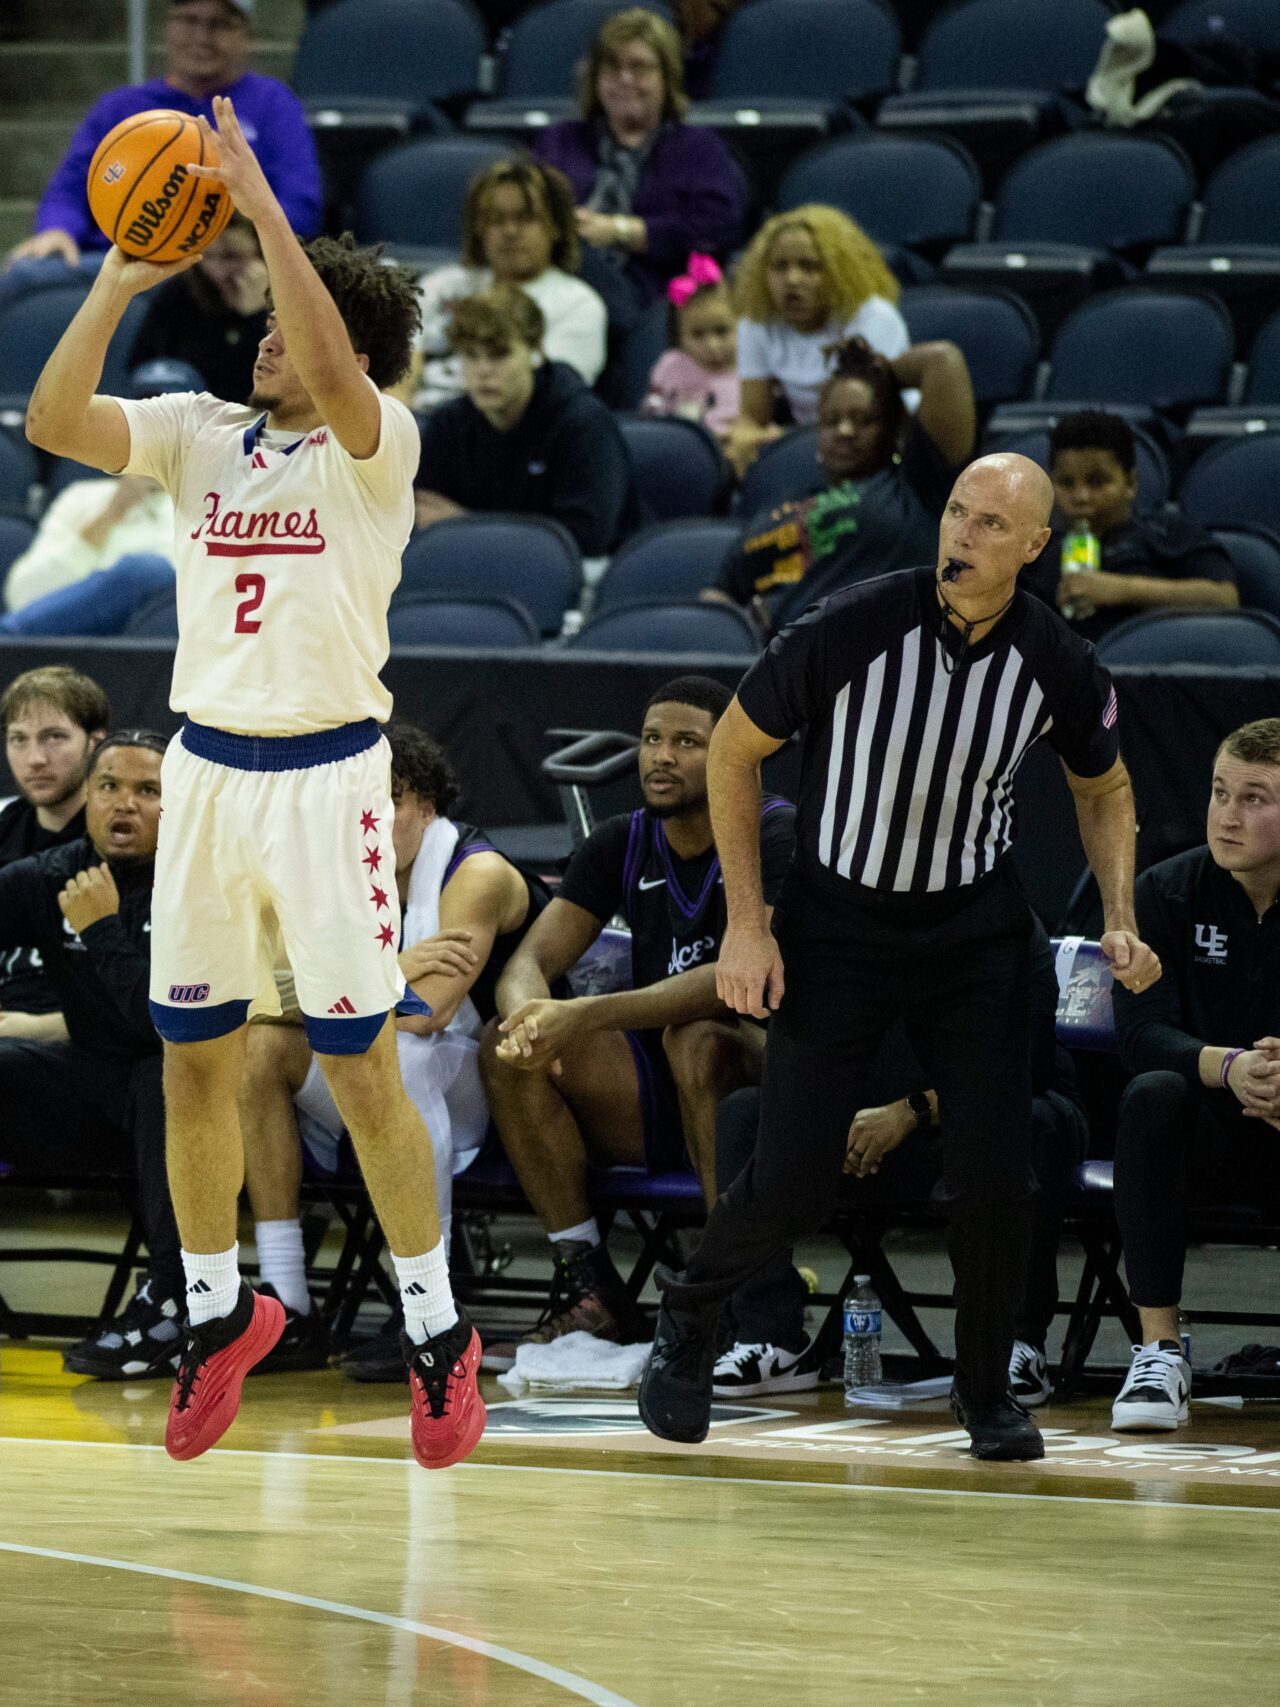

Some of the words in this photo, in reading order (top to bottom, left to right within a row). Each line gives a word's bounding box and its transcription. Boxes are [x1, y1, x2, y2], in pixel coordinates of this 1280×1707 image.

[124, 164, 189, 247] Wilson
[177, 192, 221, 253] NCAA
[191, 491, 325, 549] Flames
[234, 573, 266, 634] 2
[168, 983, 210, 1003] UIC
[701, 1437, 941, 1457] FEDERAL
